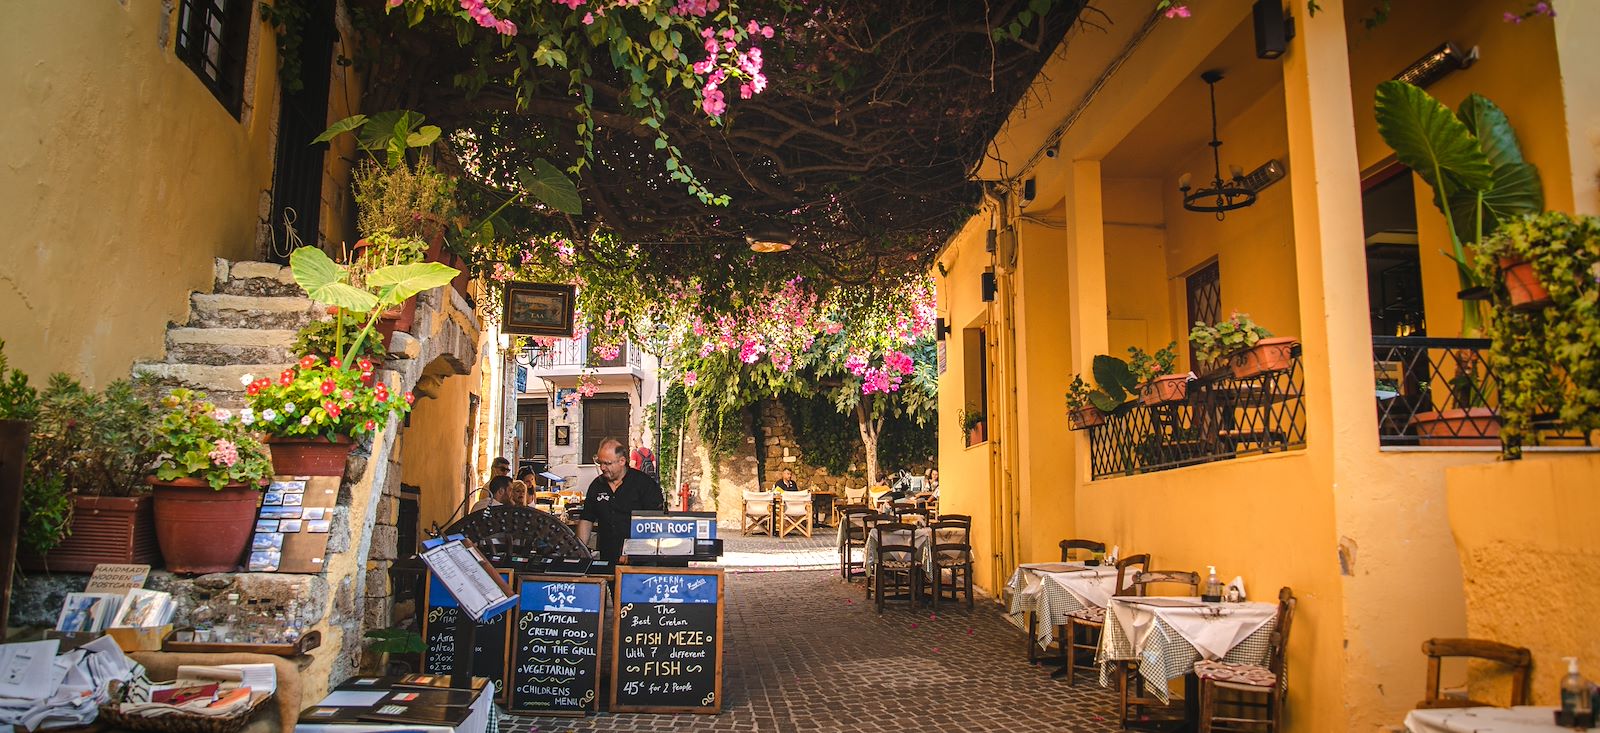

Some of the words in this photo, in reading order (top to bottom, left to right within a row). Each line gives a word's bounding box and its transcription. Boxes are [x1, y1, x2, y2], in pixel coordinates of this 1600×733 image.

[636, 522, 662, 533] OPEN
[667, 522, 695, 533] ROOF
[90, 581, 140, 589] POSTCARD
[654, 604, 676, 614] The
[539, 612, 578, 624] TYPICAL
[631, 616, 651, 627] Best
[658, 616, 688, 626] Cretan
[528, 627, 558, 637] CRETAN
[563, 629, 587, 638] FOOD
[635, 632, 662, 645] FISH
[667, 631, 704, 646] MEZE
[532, 645, 547, 655] ON
[552, 645, 569, 655] THE
[571, 646, 596, 656] GRILL
[625, 647, 645, 659] With
[650, 647, 658, 658] 7
[669, 647, 706, 659] different
[522, 664, 576, 676] VEGETARIAN
[644, 661, 681, 677] FISH
[522, 684, 570, 696] CHILDRENS
[648, 682, 661, 694] for
[662, 682, 669, 693] 2
[554, 697, 578, 706] MENU
